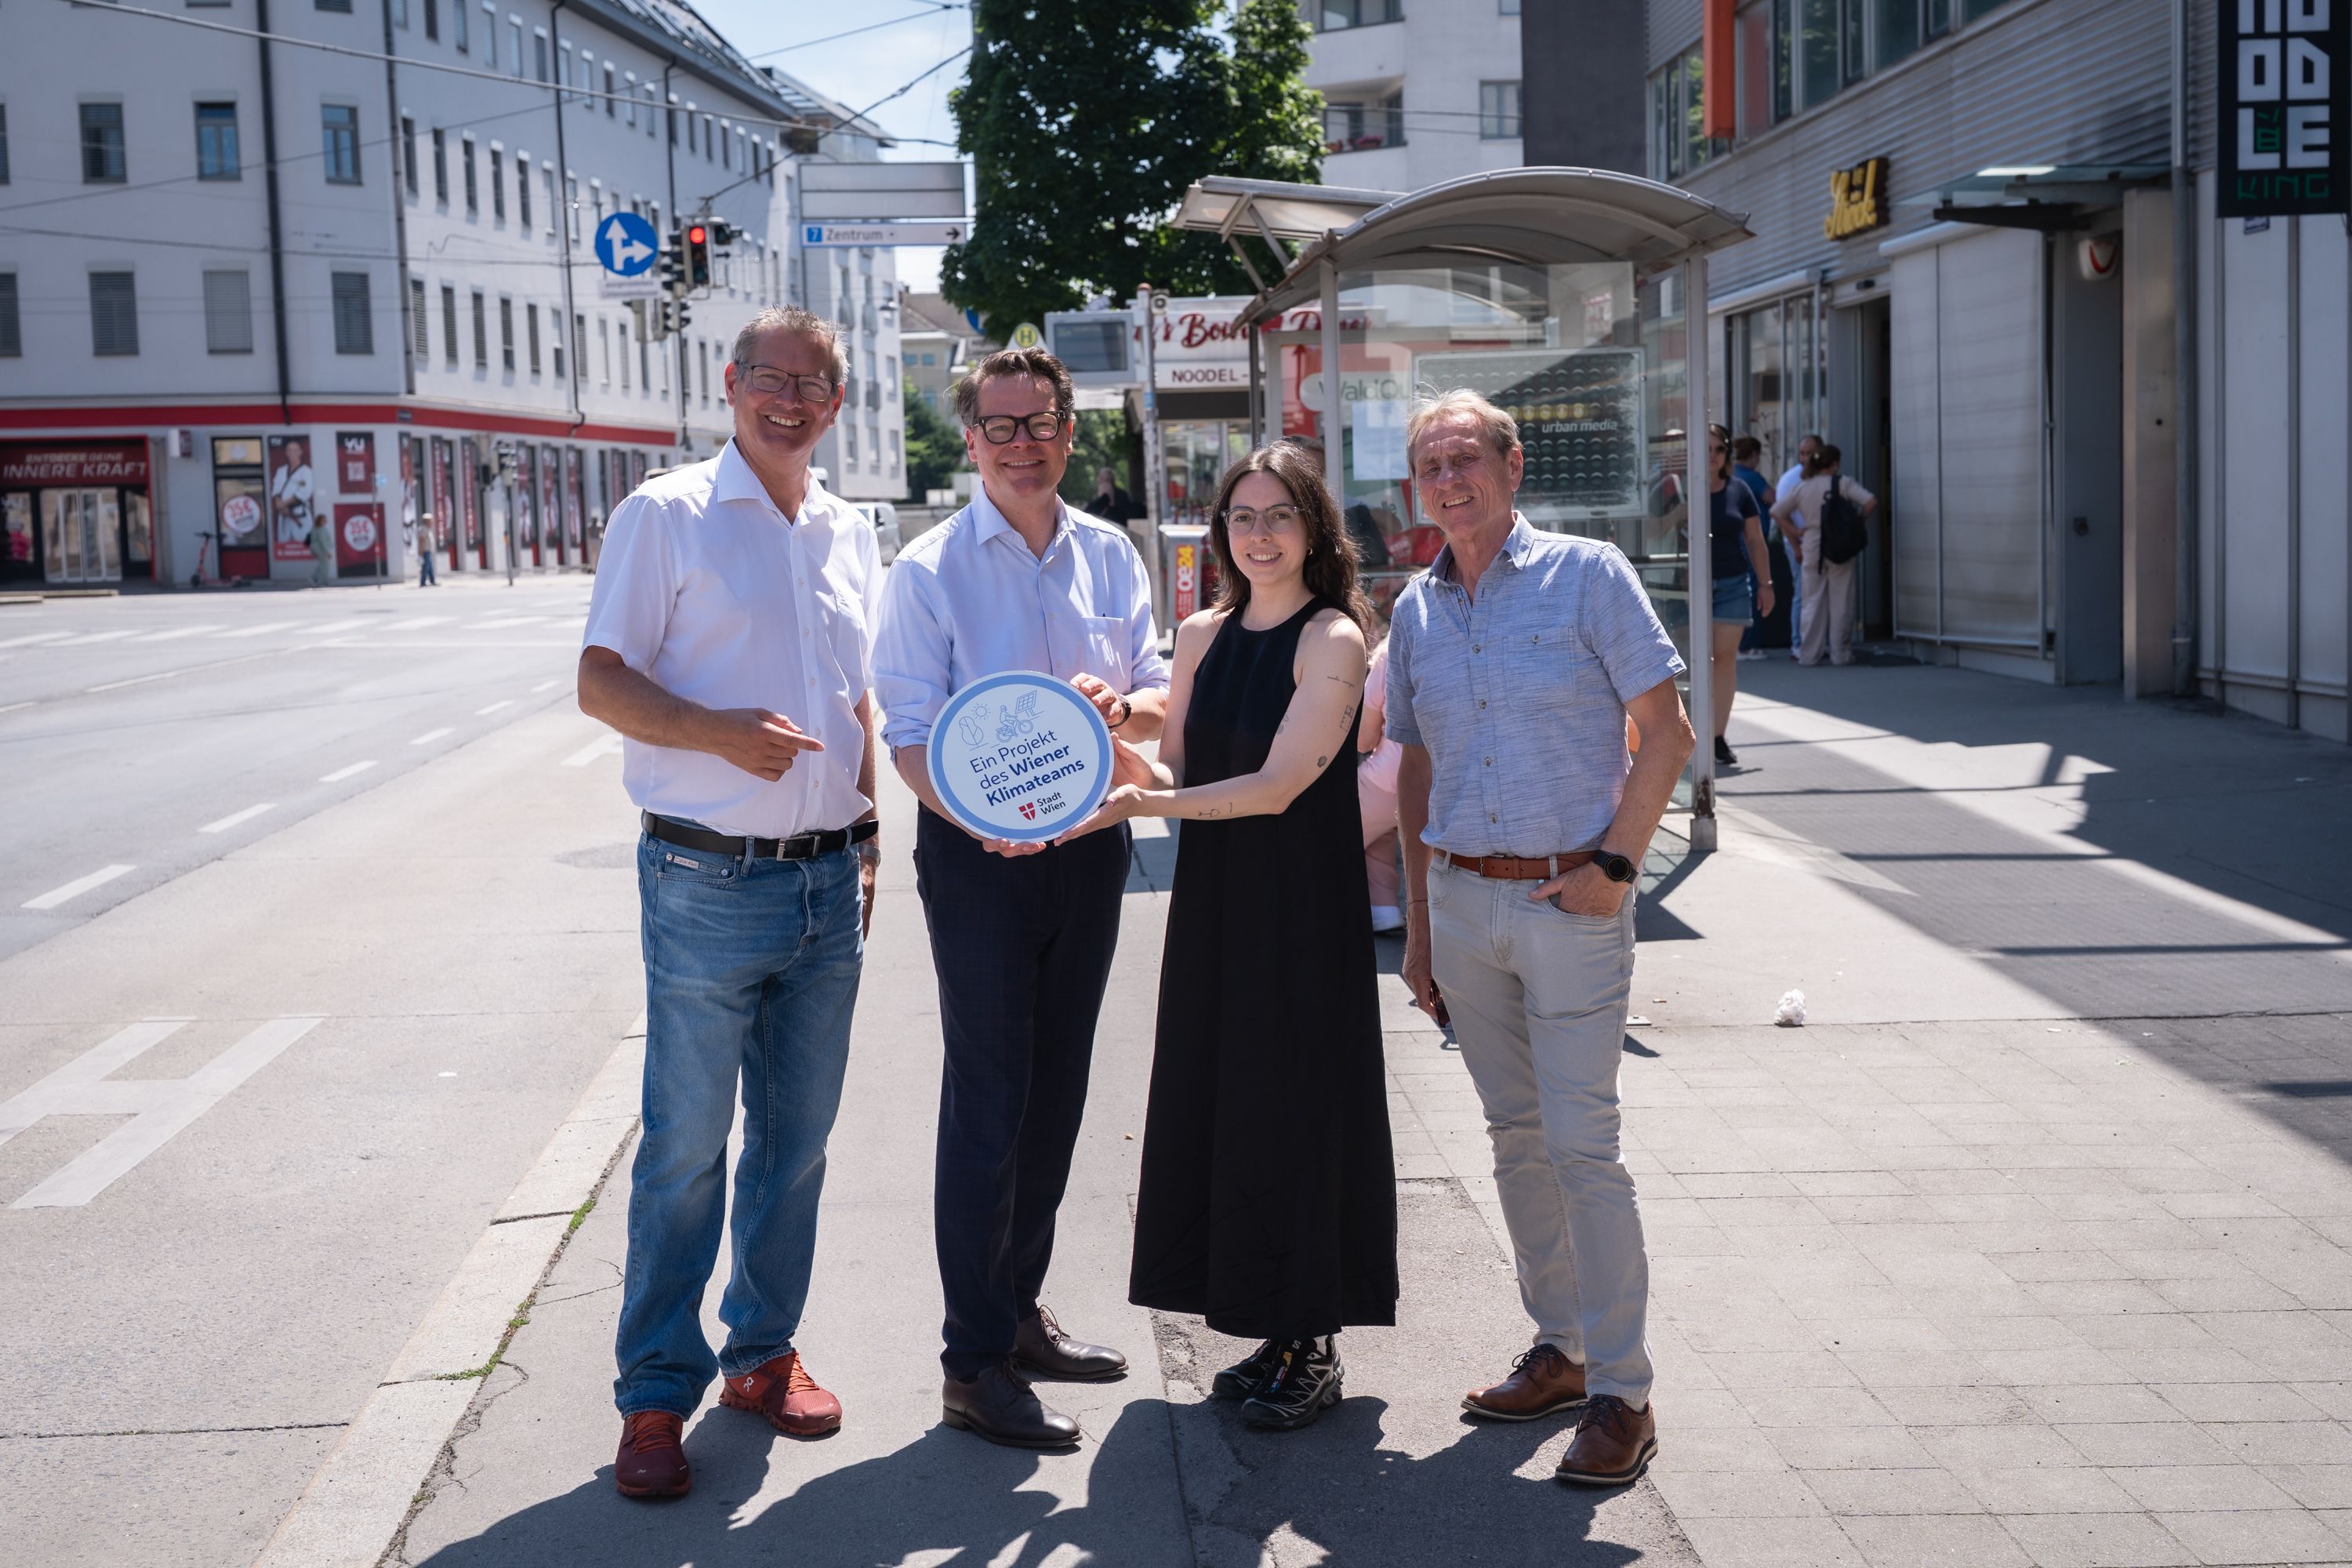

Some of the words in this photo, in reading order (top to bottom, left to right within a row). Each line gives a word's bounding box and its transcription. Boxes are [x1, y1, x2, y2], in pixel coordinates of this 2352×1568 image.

[2238, 173, 2330, 200] KING
[826, 228, 884, 241] Zentrum
[1020, 329, 1032, 343] H
[1172, 368, 1238, 383] NOODEL
[1541, 419, 1577, 434] urban
[1580, 418, 1618, 432] media
[3, 463, 77, 479] INNERE
[82, 461, 147, 477] KRAFT
[1177, 546, 1194, 592] oe24
[970, 757, 997, 773] Ein
[998, 730, 1058, 762] Projekt
[980, 771, 1009, 789] des
[1008, 745, 1070, 776] Wiener
[985, 760, 1085, 807] Klimateams
[1036, 792, 1062, 807] Stadt
[1040, 800, 1066, 815] Wien
